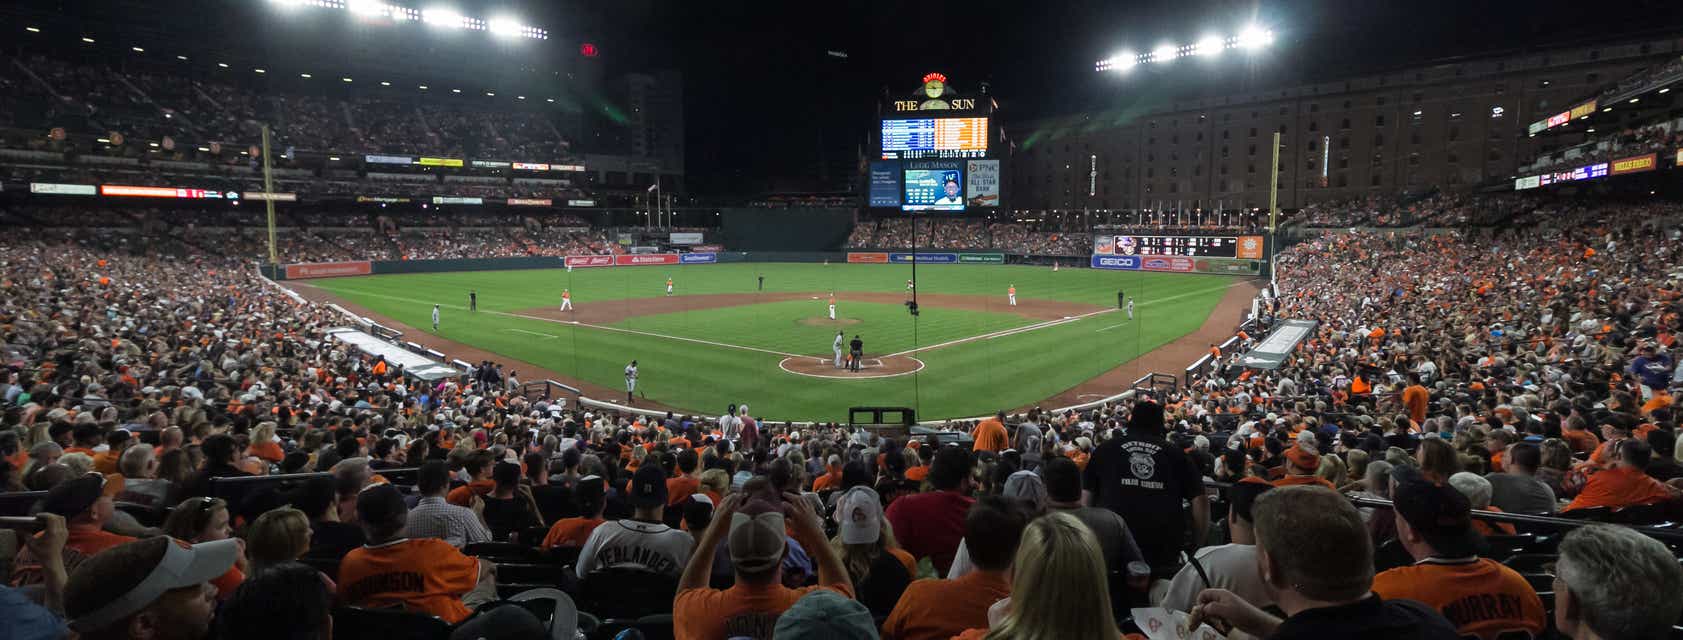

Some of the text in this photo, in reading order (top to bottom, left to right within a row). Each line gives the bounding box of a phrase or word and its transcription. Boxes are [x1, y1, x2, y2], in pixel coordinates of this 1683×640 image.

[923, 72, 947, 83] ORIOLES
[895, 99, 975, 111] THE SUN
[1100, 258, 1133, 266] GEICO
[1121, 441, 1162, 451] DETROIT
[1443, 592, 1522, 626] MURRAY
